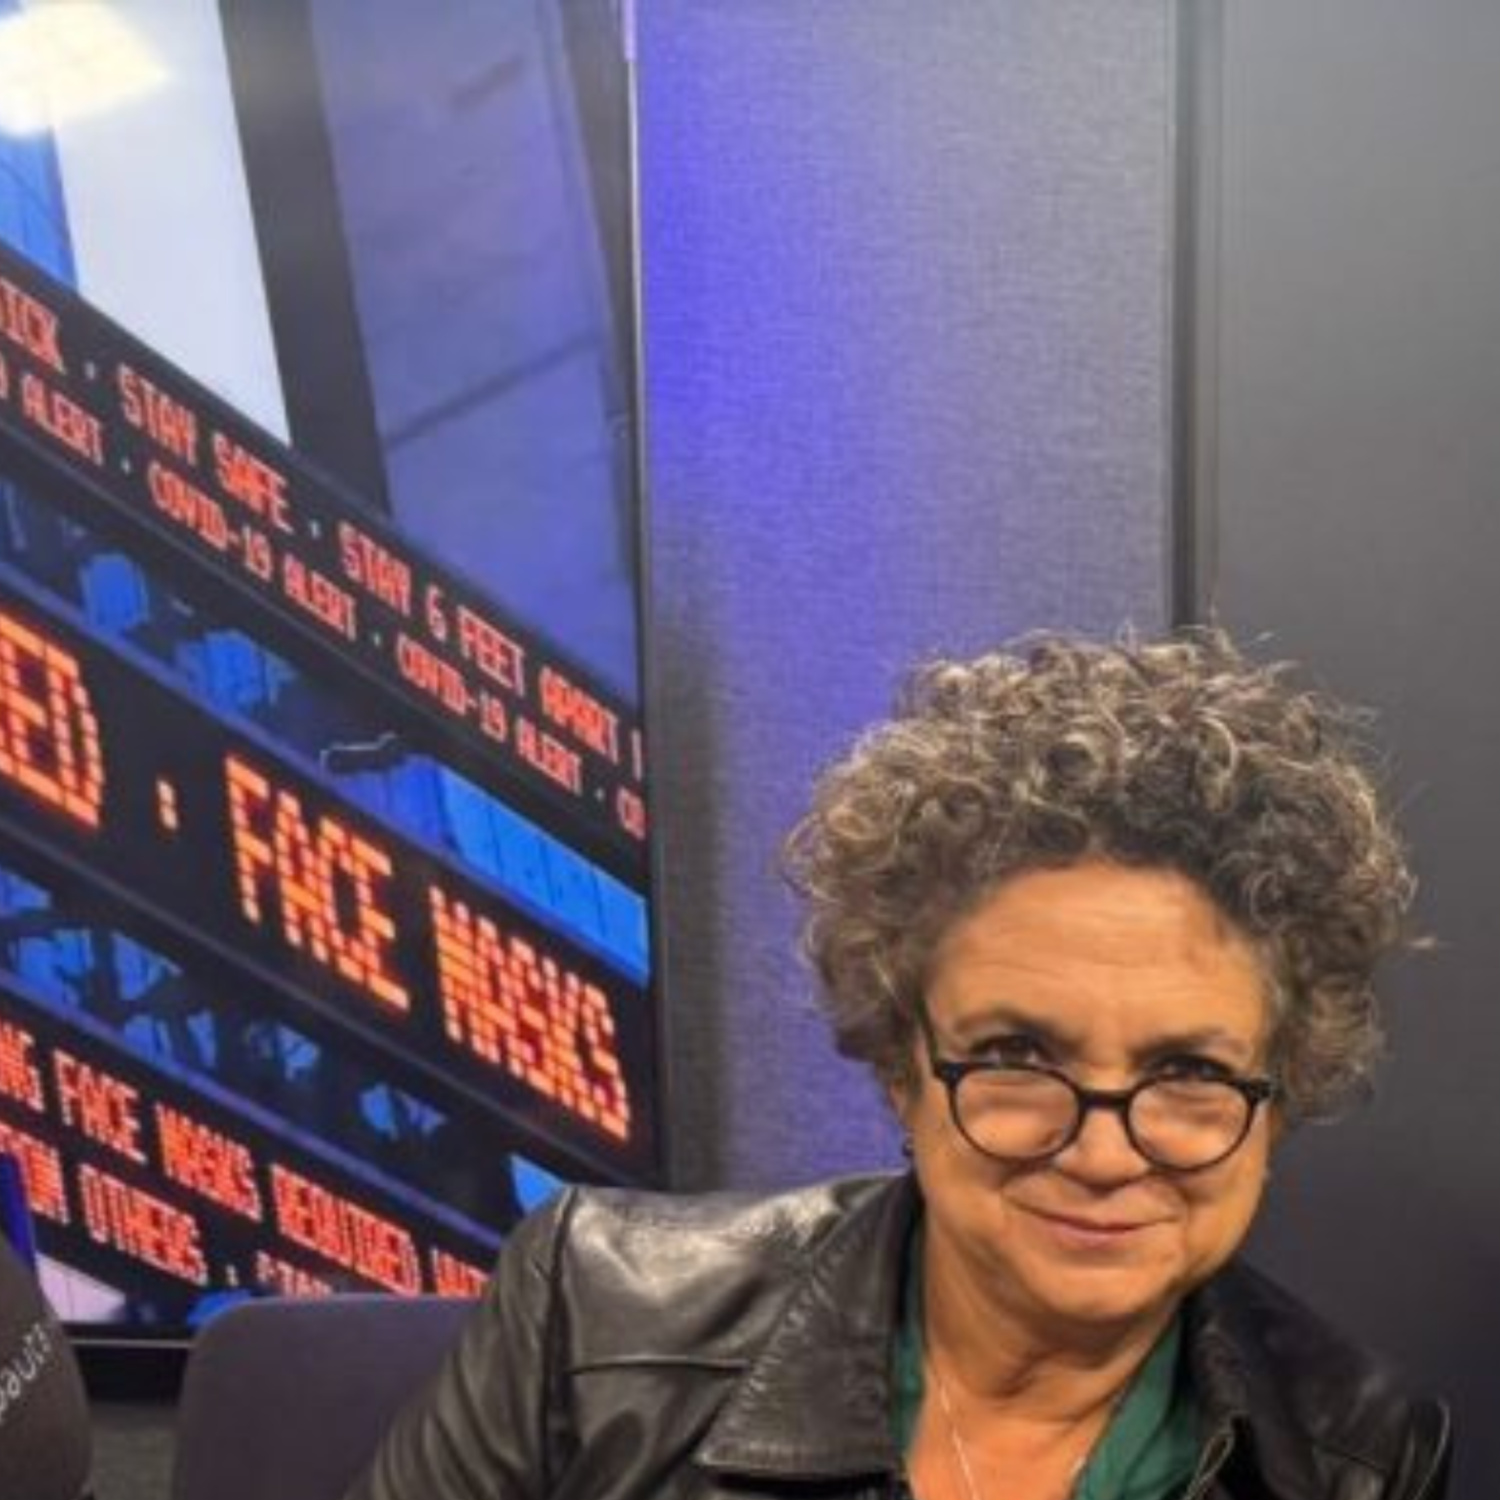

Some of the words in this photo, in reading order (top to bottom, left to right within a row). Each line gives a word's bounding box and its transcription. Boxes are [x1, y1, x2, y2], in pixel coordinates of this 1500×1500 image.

[22, 373, 103, 465] ALERT
[149, 460, 272, 581] COVID-19
[284, 553, 356, 642] ALERT
[398, 632, 506, 743] COVID-19
[516, 716, 581, 796] ALERT
[118, 362, 196, 465] STAY
[212, 431, 293, 533] SAFE
[339, 520, 411, 617] STAY
[458, 604, 524, 697] FEET
[0, 612, 104, 830] ED
[225, 755, 409, 1010] FACE
[429, 884, 630, 1141] MASKS
[54, 1048, 147, 1164] FACE
[155, 1101, 262, 1223] MASKS
[270, 1161, 421, 1298] REQUIRED
[79, 1162, 208, 1286] OTHERS
